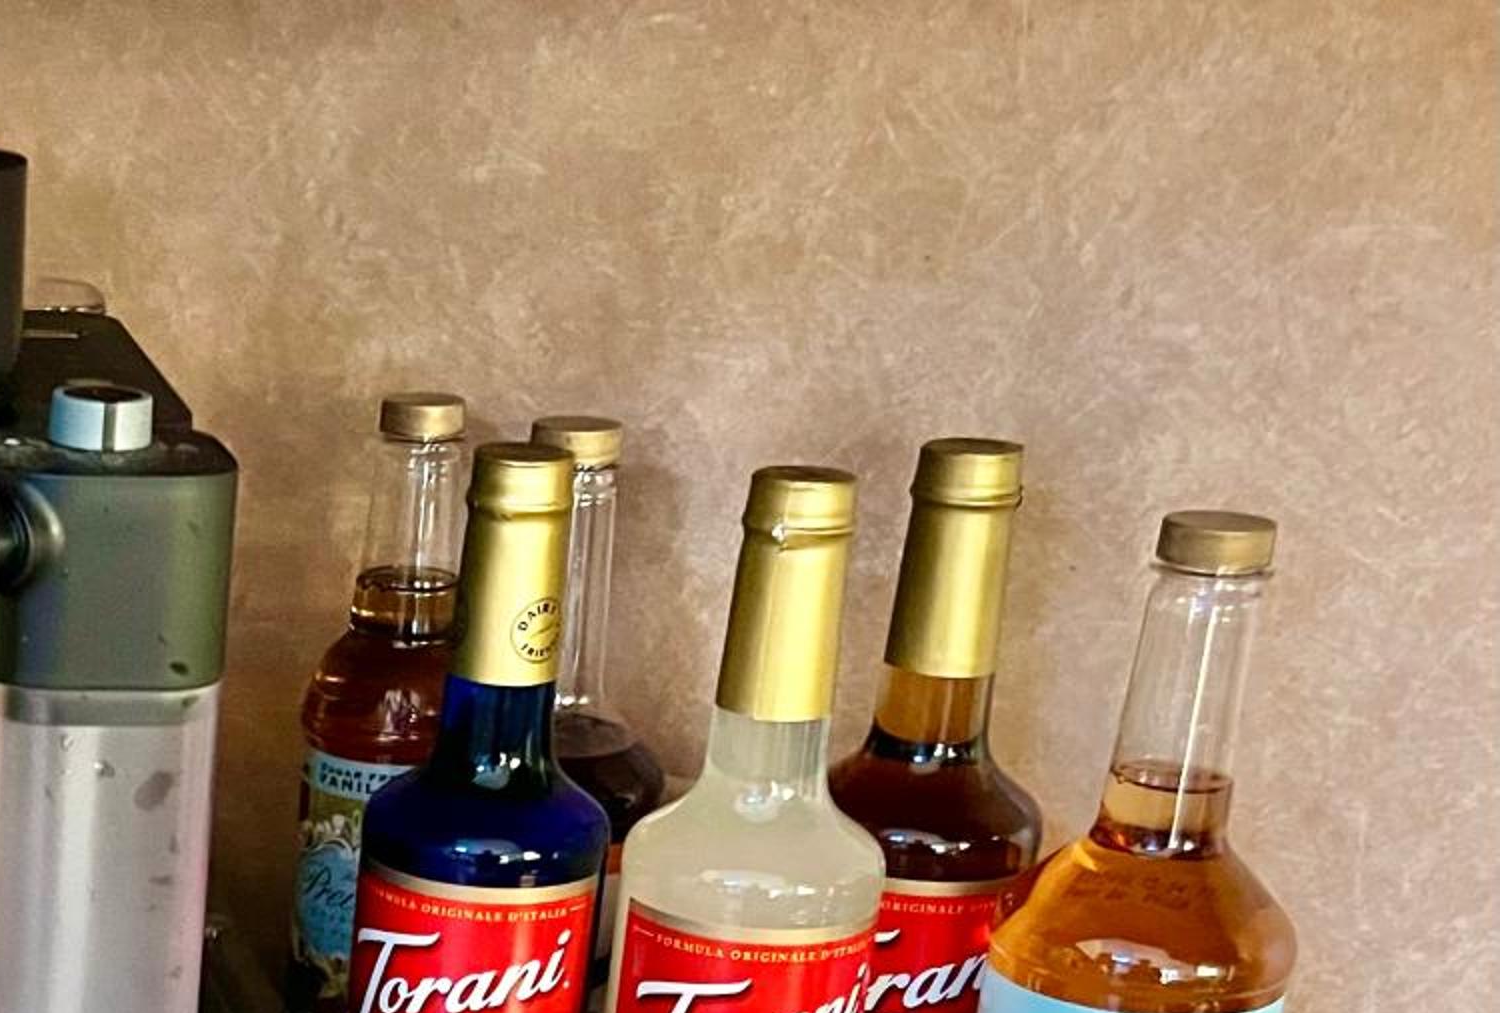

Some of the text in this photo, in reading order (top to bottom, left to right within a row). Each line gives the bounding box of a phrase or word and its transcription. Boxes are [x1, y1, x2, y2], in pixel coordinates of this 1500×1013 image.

[320, 773, 373, 795] VANIL
[421, 901, 501, 922] ORIGINALE
[657, 933, 725, 958] FORMULA
[730, 948, 817, 963] ORIGINALE
[864, 953, 987, 1010] ran
